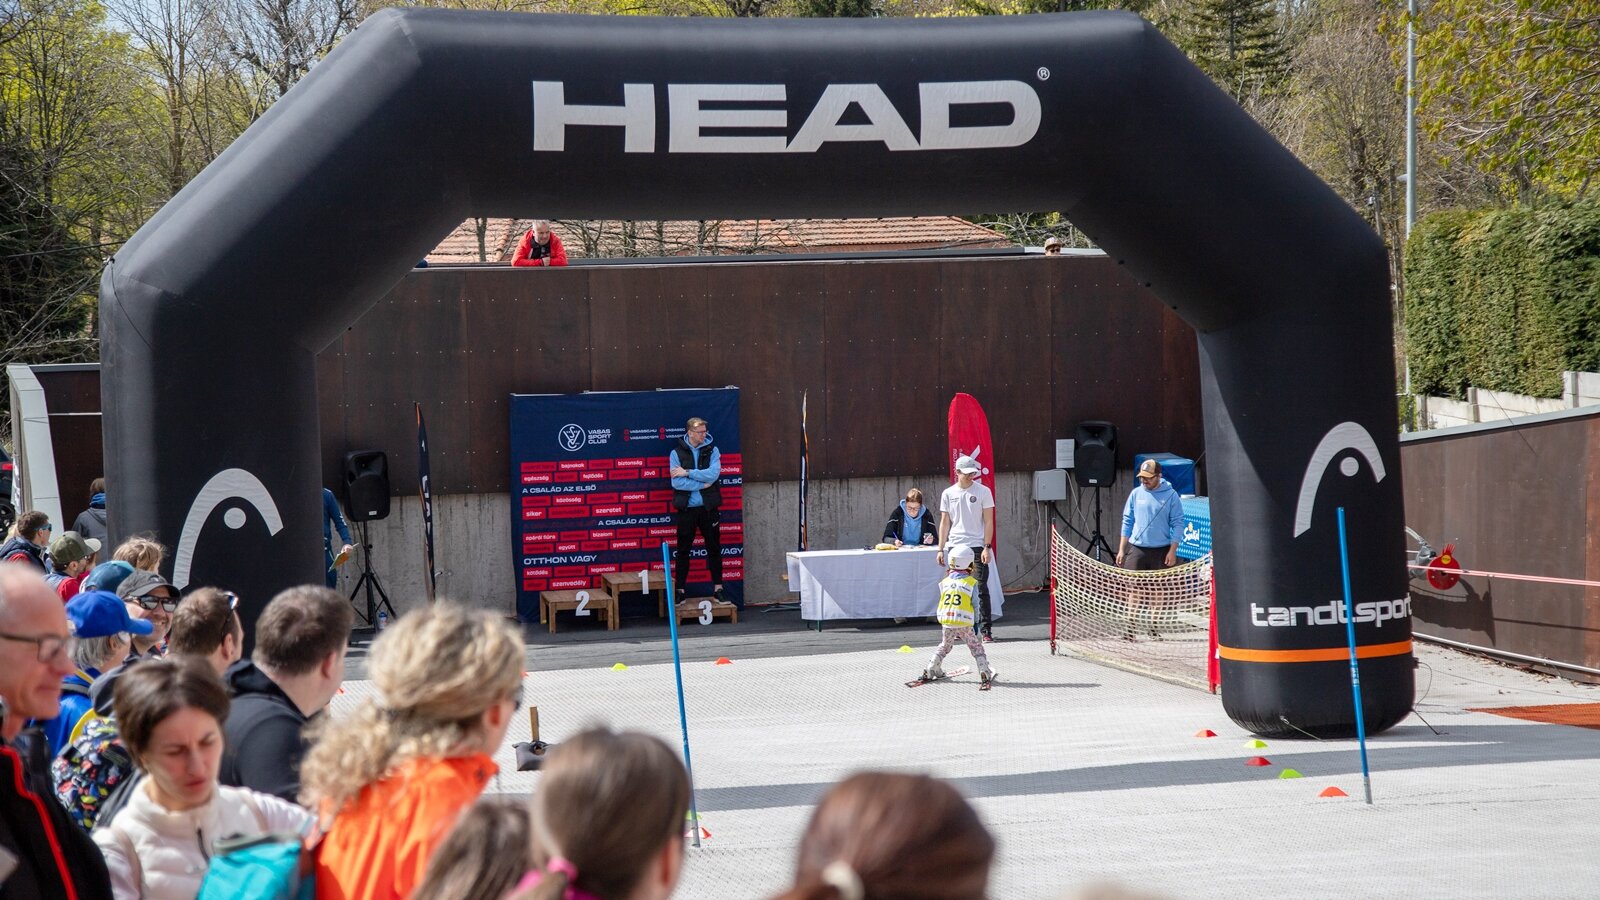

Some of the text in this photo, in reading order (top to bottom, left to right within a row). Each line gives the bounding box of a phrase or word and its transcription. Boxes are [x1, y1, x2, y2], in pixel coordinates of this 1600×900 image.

[533, 80, 1042, 153] HEAD
[530, 486, 561, 494] CSALÁD
[576, 484, 597, 492] ELSŐ
[605, 518, 637, 526] CSALÁD
[523, 556, 567, 565] OTTHON
[569, 554, 597, 563] VAGY
[638, 569, 649, 595] 1
[575, 590, 591, 616] 2
[944, 593, 962, 606] 23
[1250, 592, 1412, 628] tandtsport
[698, 600, 713, 625] 3
